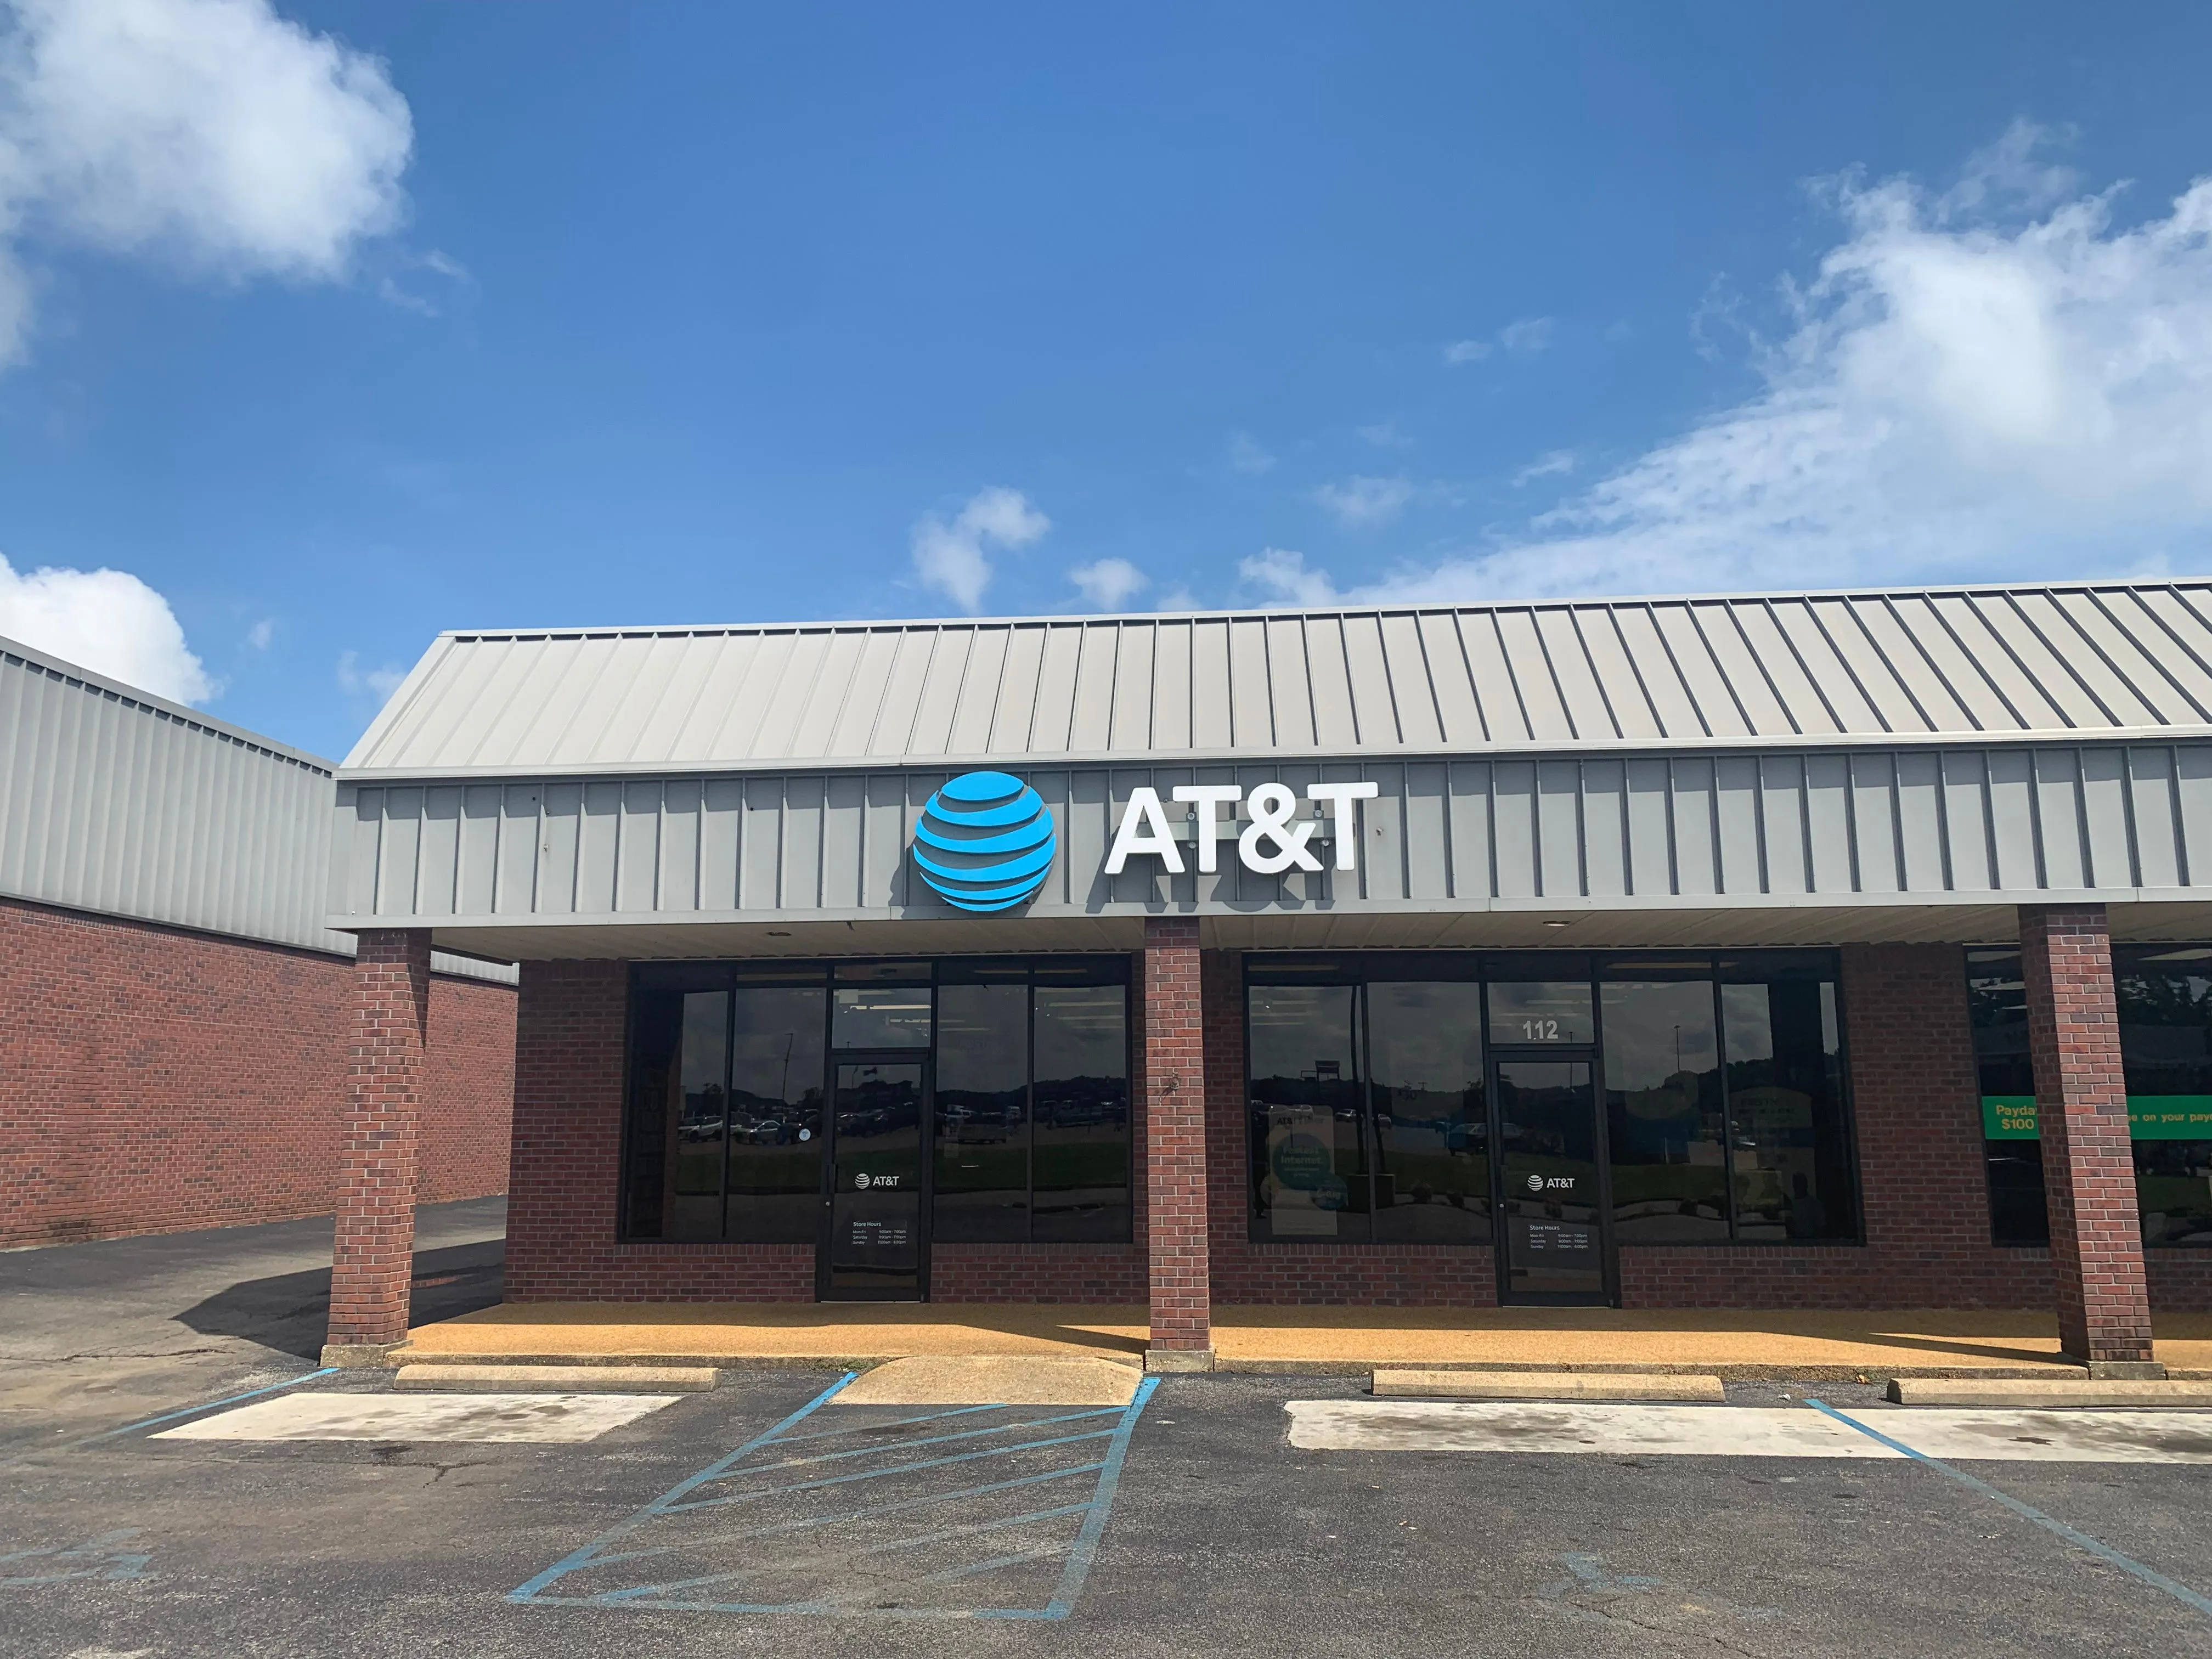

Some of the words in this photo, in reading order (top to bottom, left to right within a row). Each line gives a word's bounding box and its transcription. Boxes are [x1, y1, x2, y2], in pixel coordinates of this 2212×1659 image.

[1104, 782, 1379, 874] AT&T
[1523, 1020, 1559, 1039] 112
[1996, 1104, 2038, 1117] Payda
[2001, 1118, 2034, 1130] $100
[2161, 1114, 2185, 1123] your
[873, 1176, 900, 1186] AT&T
[1547, 1178, 1575, 1188] AT&T
